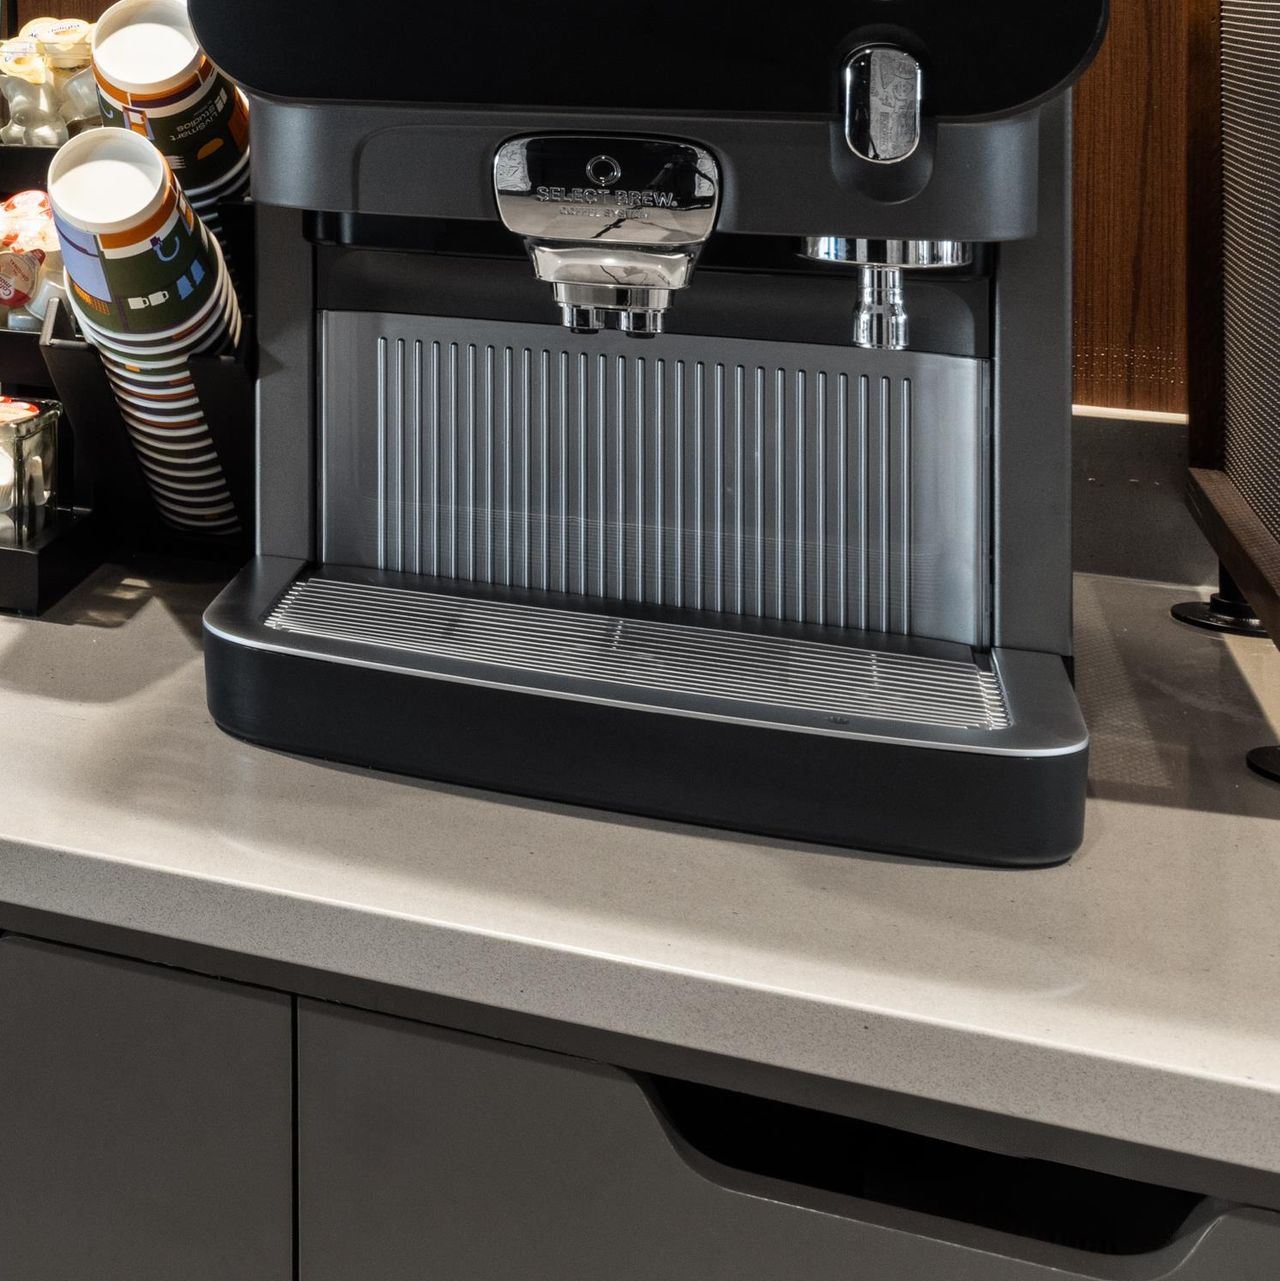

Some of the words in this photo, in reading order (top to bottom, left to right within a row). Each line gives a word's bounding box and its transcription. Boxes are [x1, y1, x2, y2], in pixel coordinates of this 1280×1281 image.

[169, 112, 218, 141] LivSmart
[176, 105, 215, 132] Studios
[536, 186, 610, 204] SELECT
